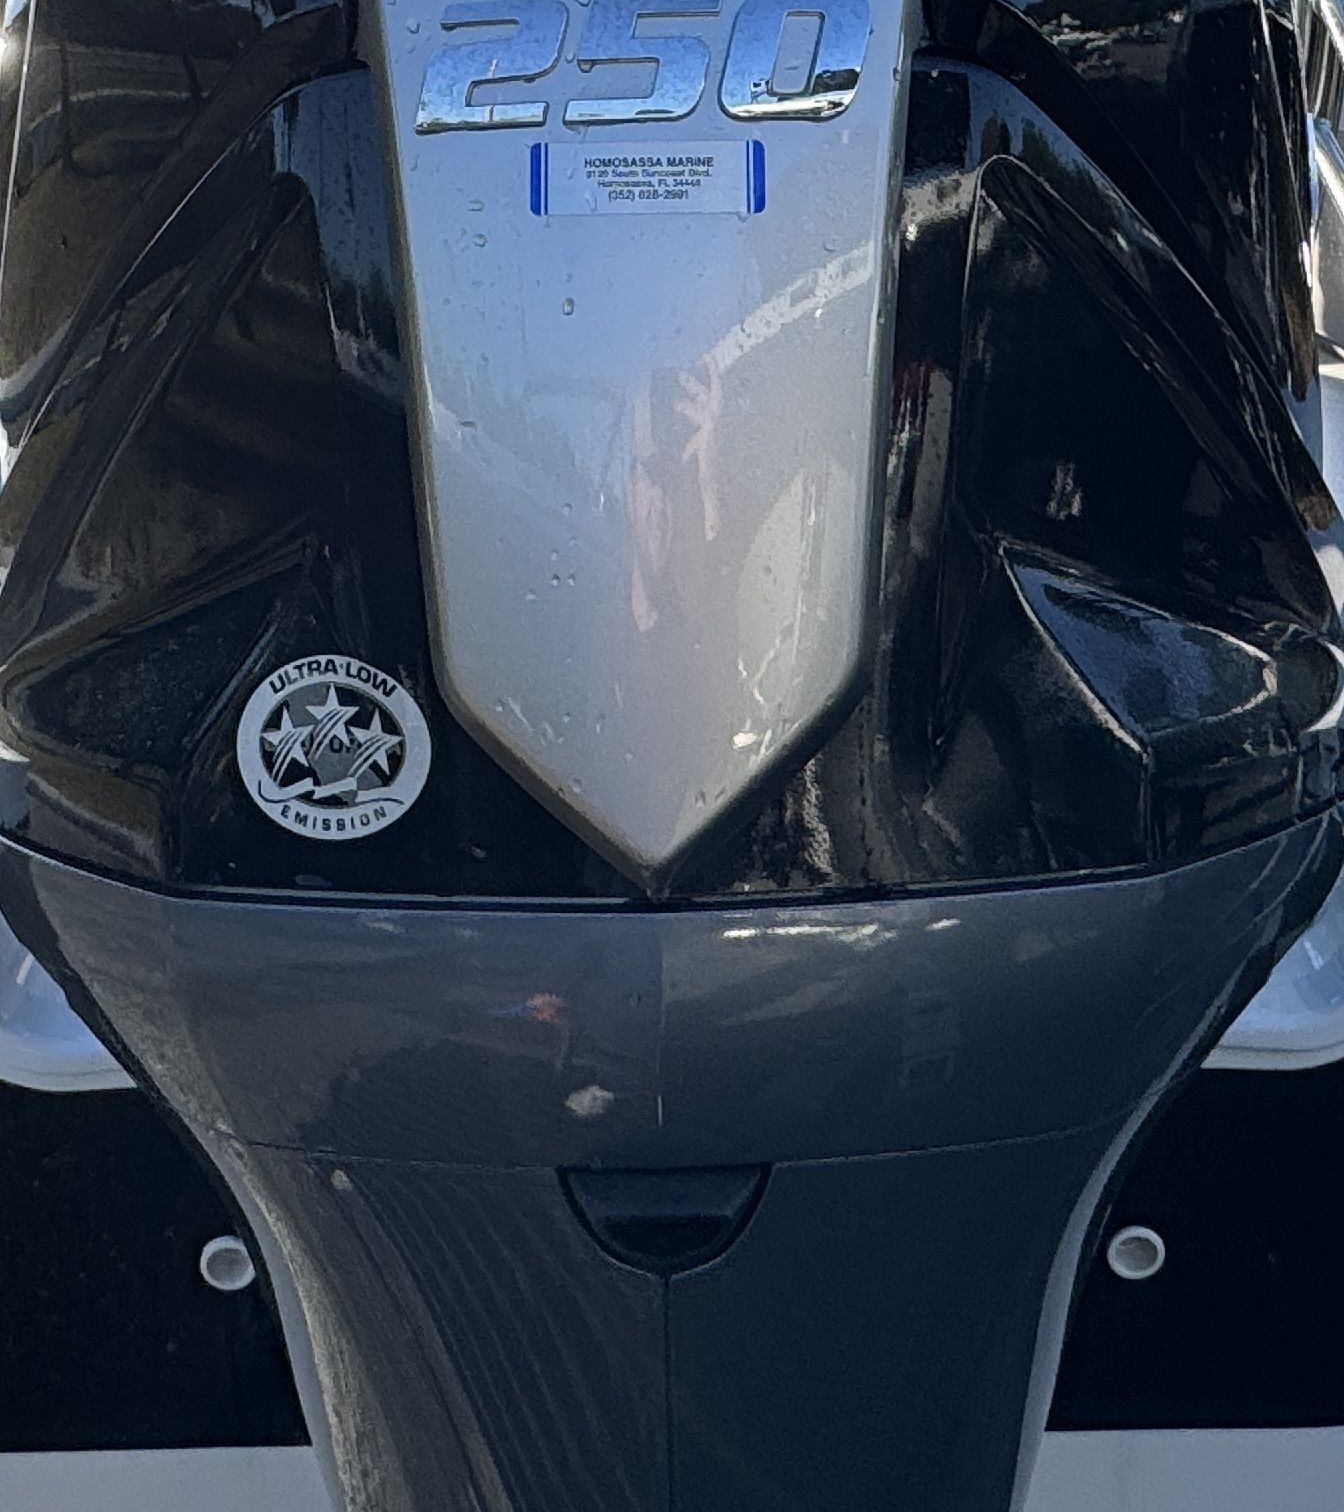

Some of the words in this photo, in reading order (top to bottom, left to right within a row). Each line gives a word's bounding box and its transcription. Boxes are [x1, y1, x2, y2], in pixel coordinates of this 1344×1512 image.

[584, 156, 663, 168] HOMOSASSA
[666, 156, 714, 168] MARINE
[608, 189, 635, 202] (352)
[280, 804, 388, 832] EMISSION
